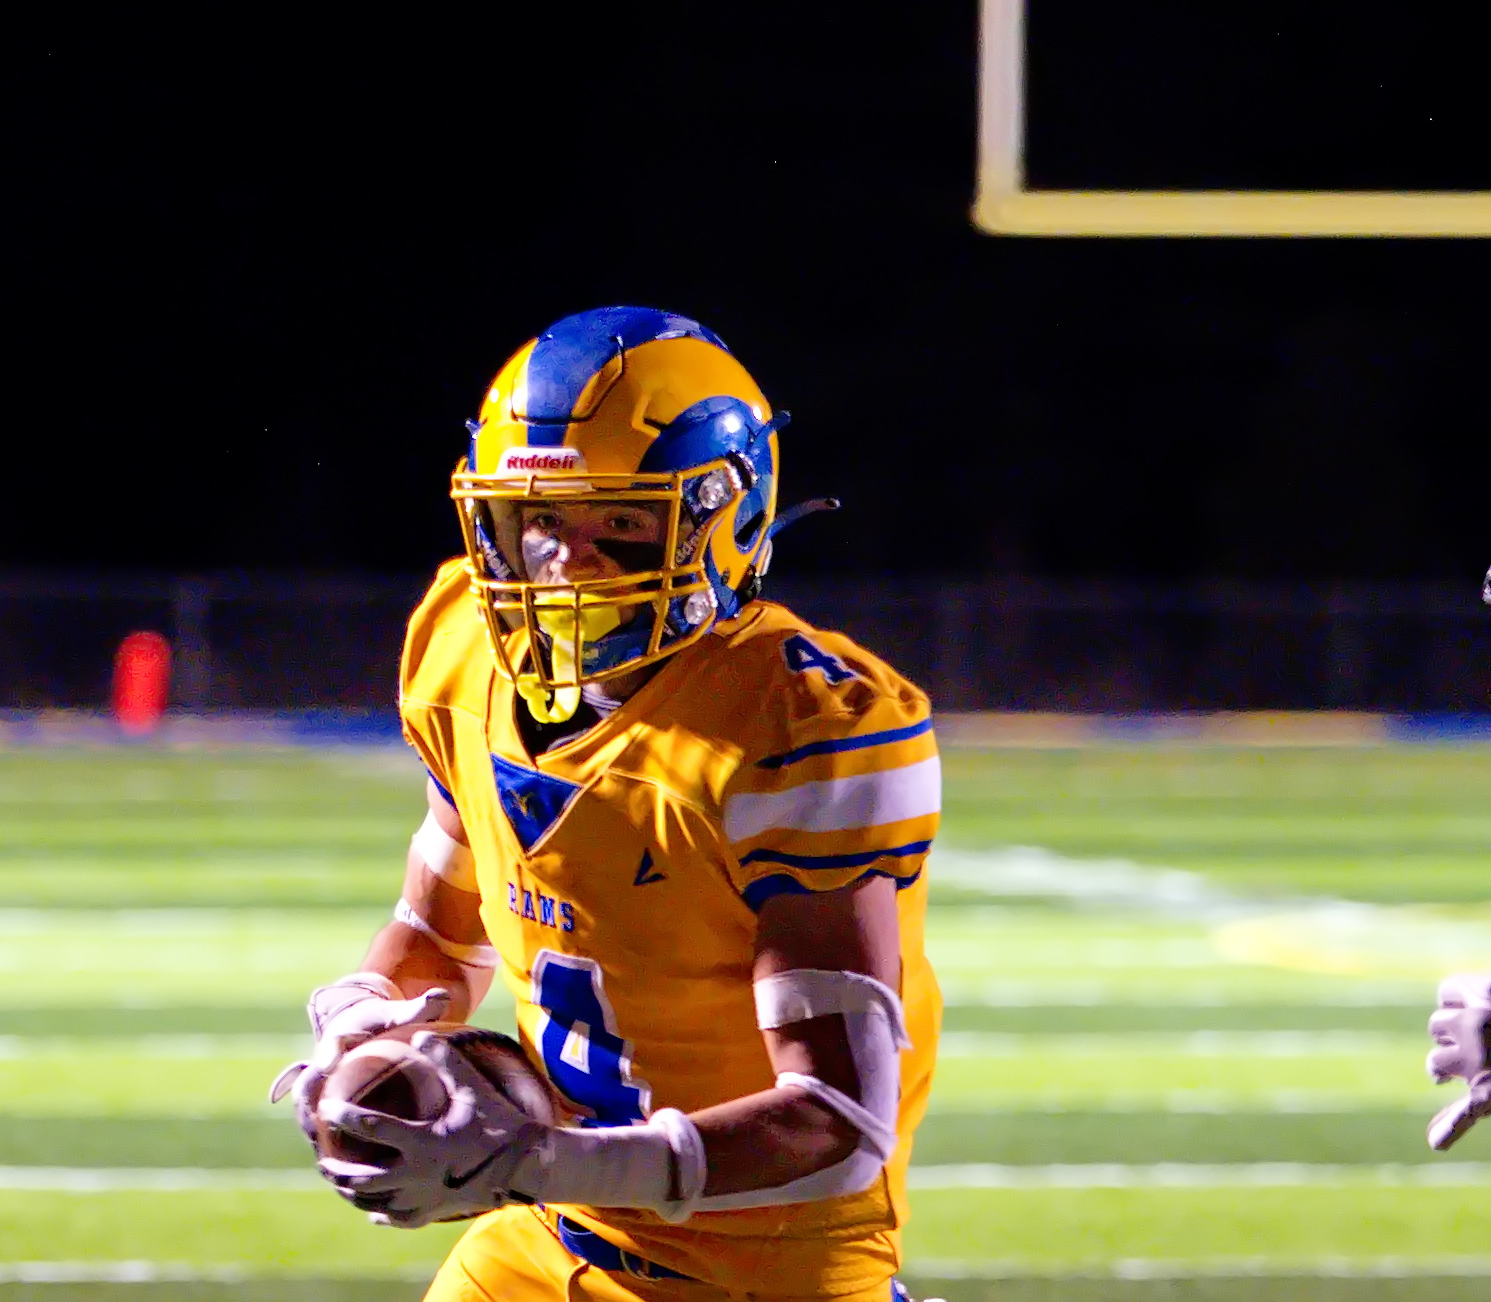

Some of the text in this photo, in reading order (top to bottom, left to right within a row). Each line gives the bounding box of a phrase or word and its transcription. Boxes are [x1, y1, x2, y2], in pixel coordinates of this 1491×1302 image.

[779, 632, 858, 686] 4
[507, 882, 576, 934] RAMS
[531, 948, 654, 1128] 4
